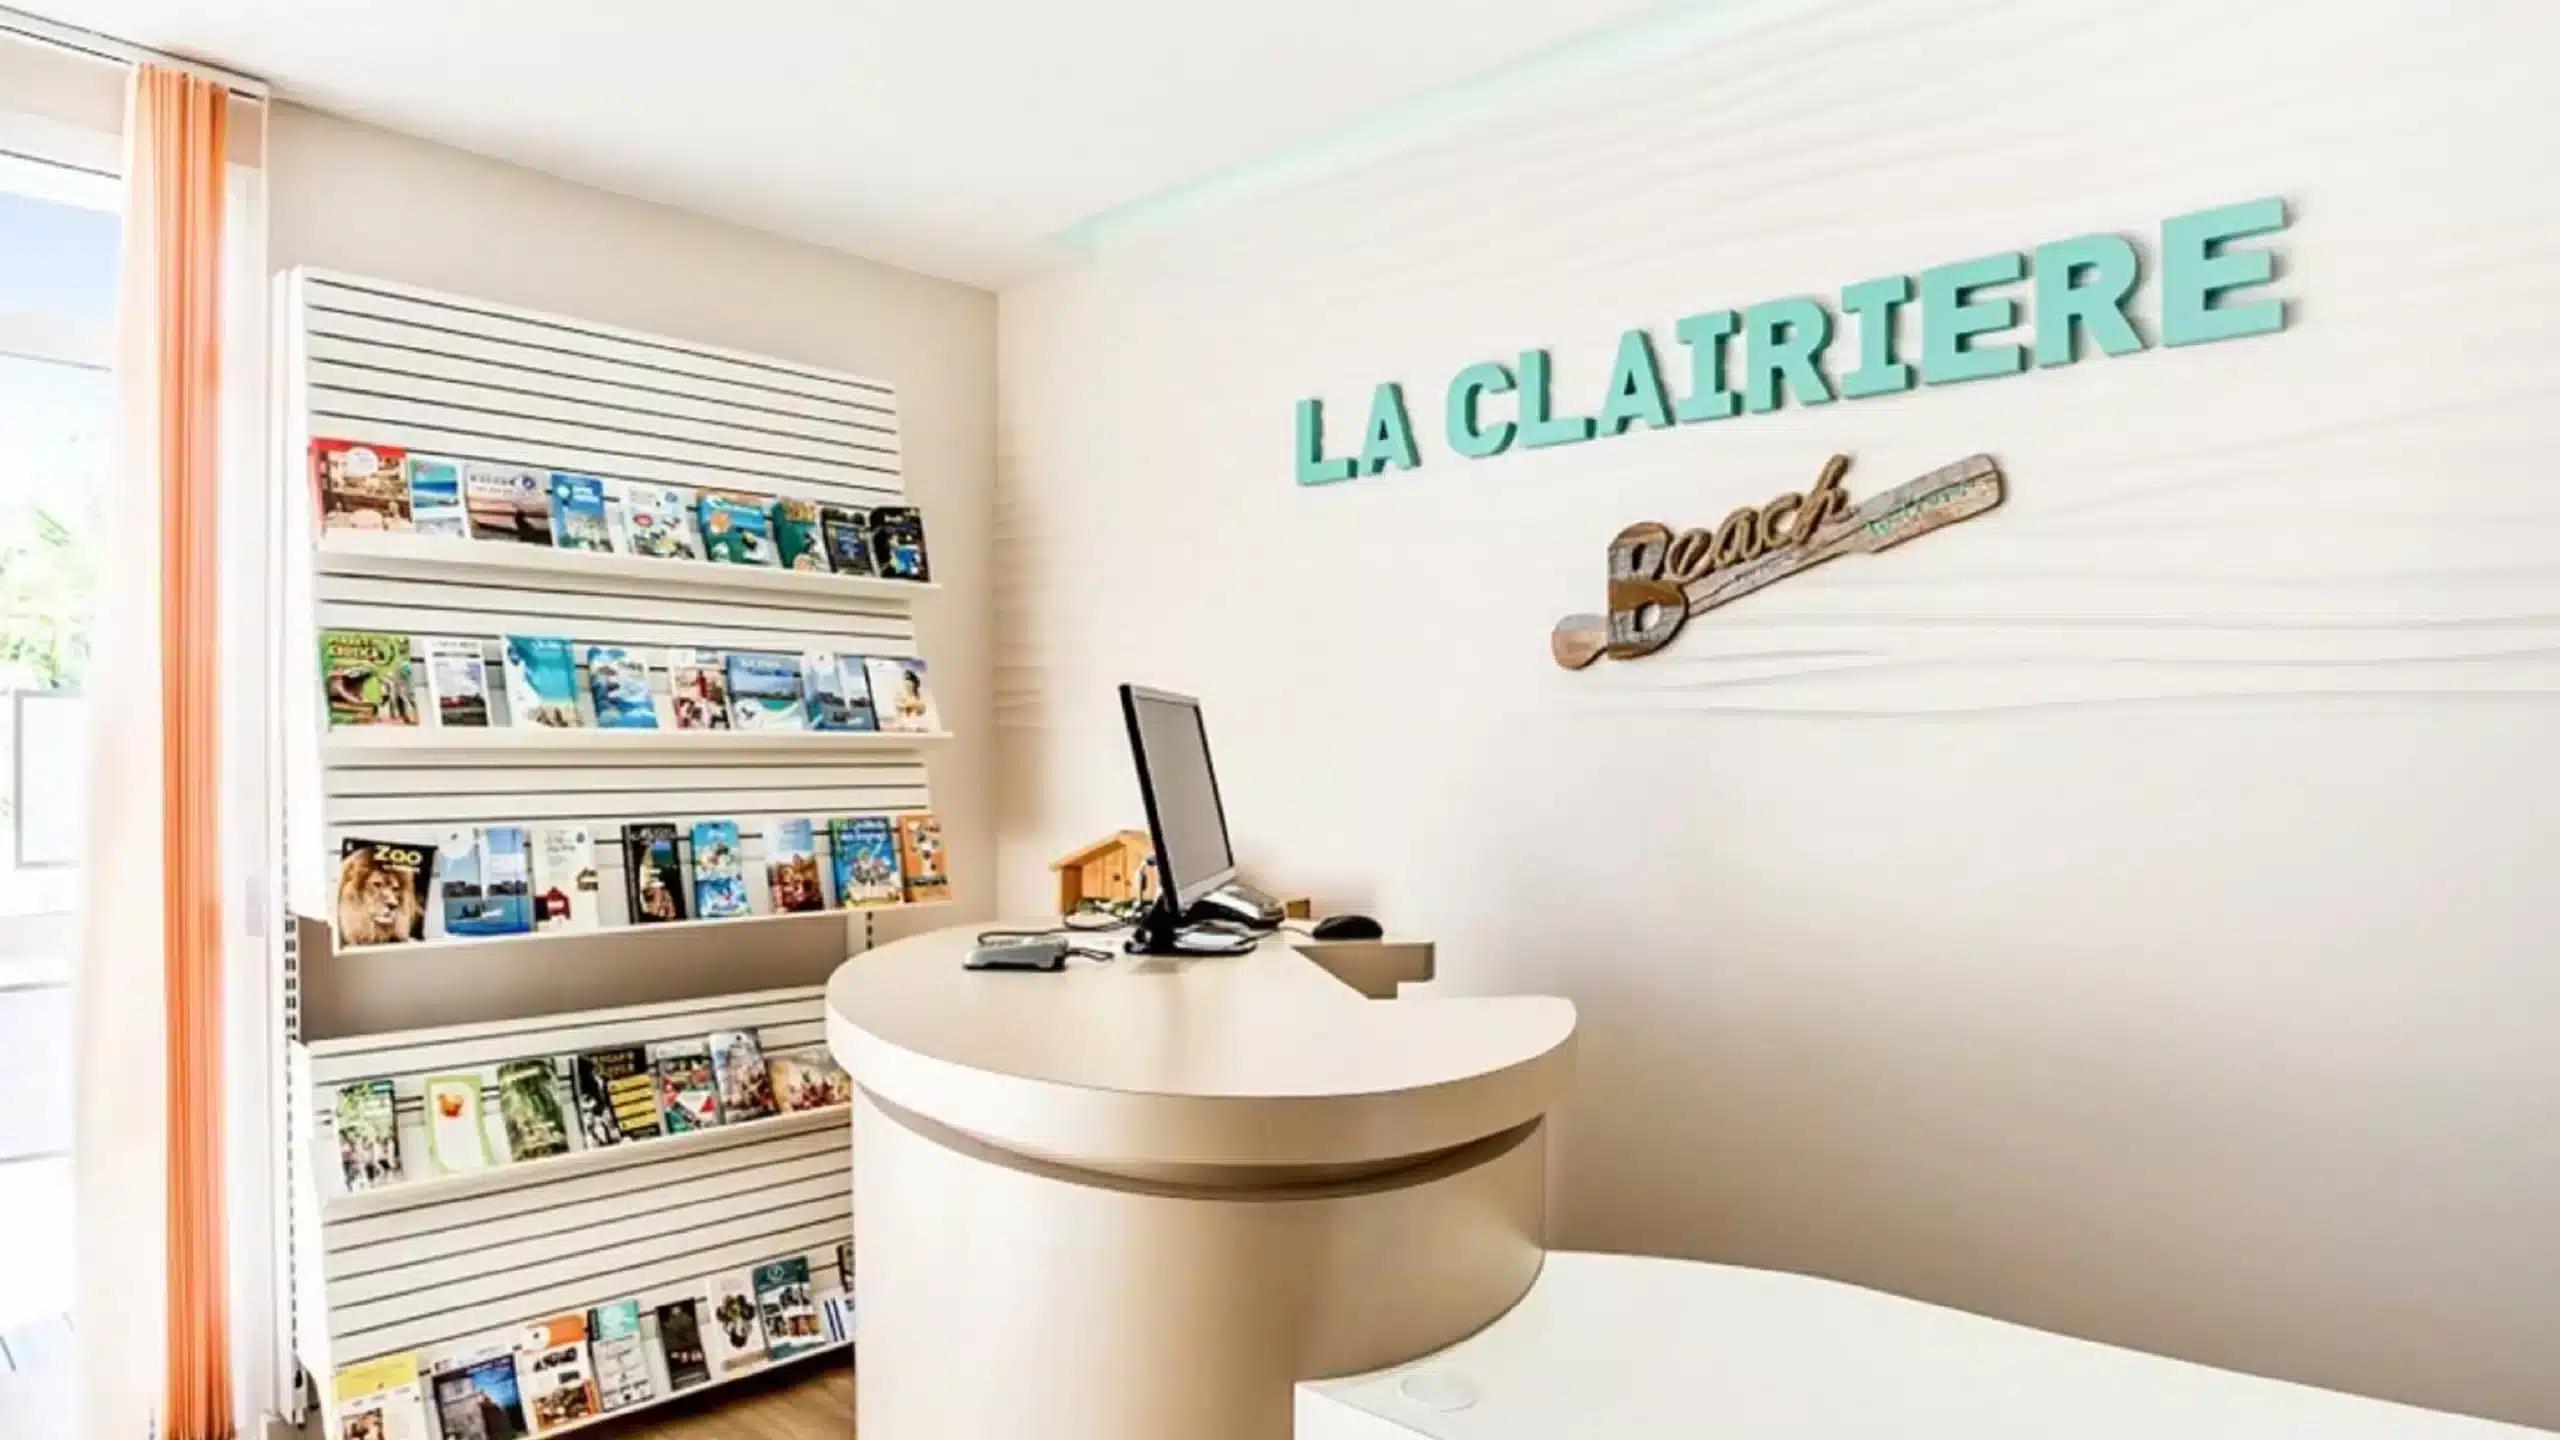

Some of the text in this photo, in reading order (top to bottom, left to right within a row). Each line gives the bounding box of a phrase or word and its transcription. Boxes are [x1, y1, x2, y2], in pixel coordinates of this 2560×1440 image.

[1295, 196, 2293, 486] LA CLAIRIERE
[1607, 453, 1856, 660] Beach
